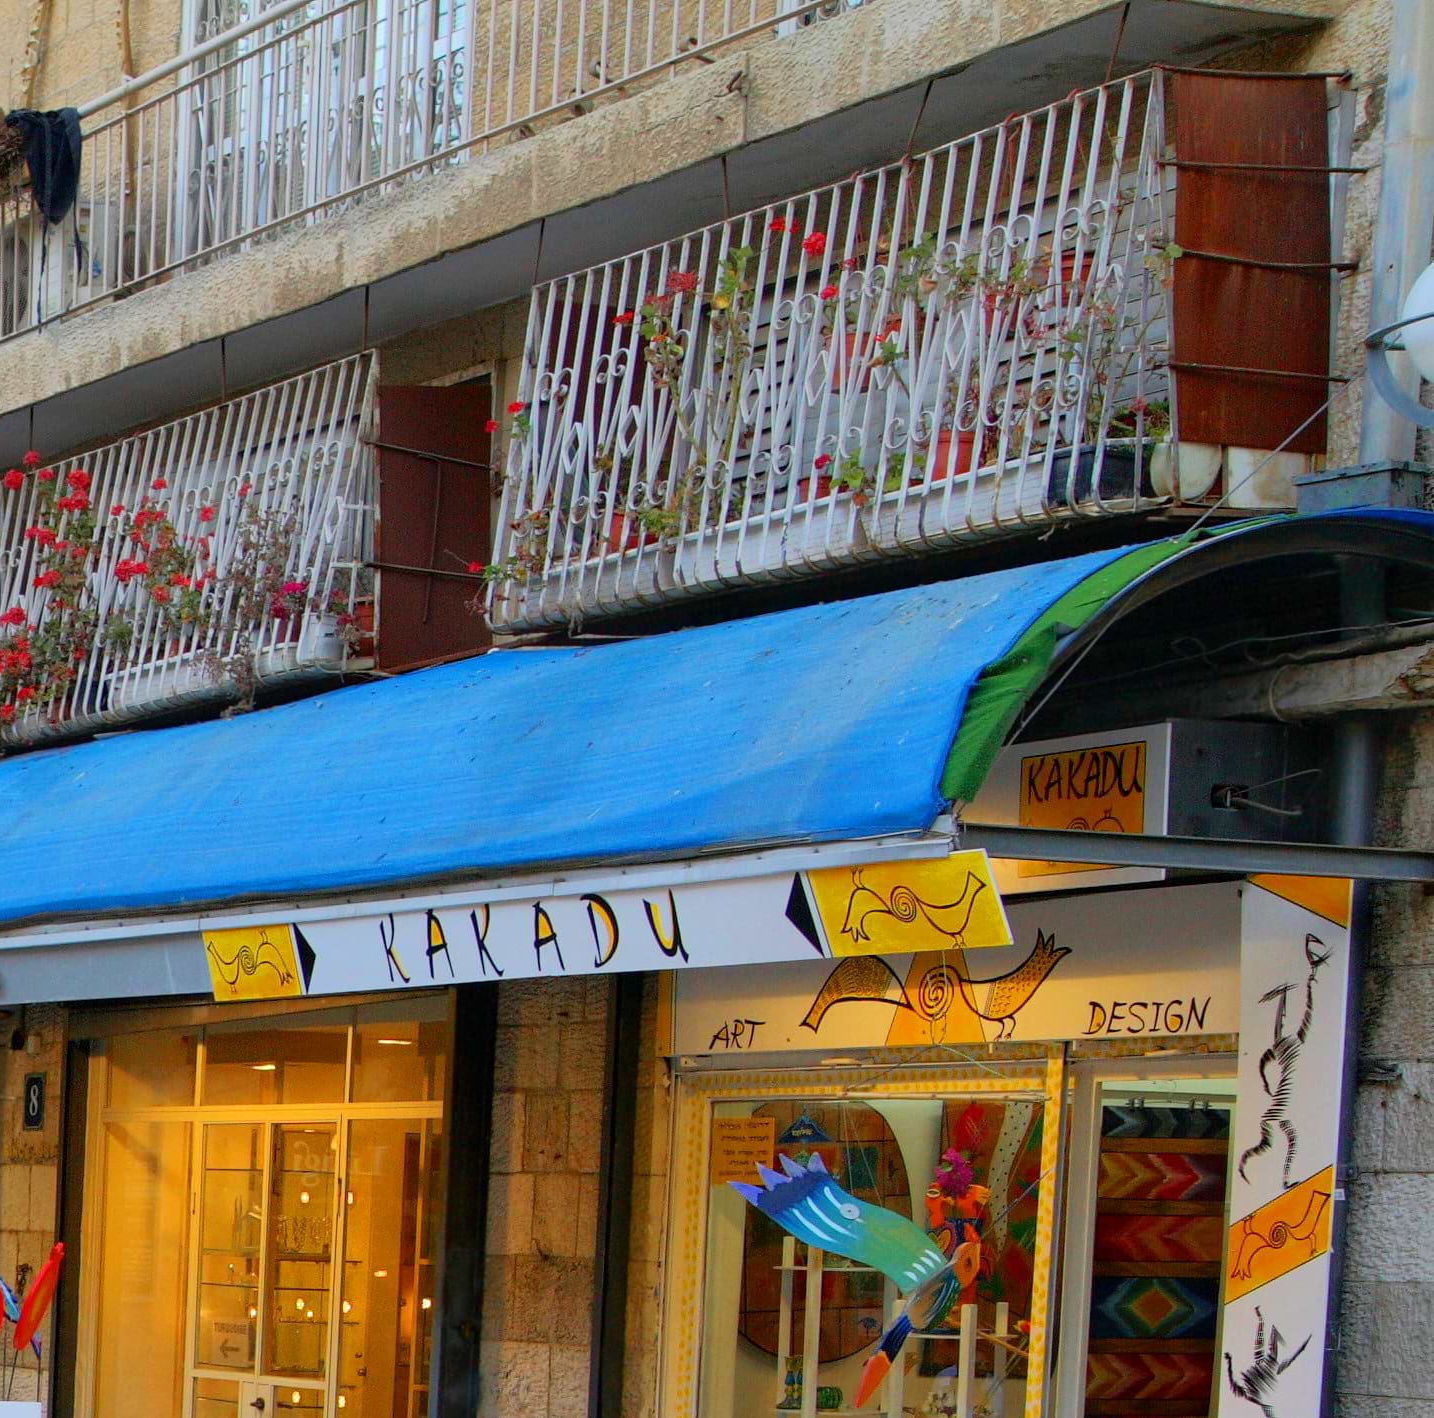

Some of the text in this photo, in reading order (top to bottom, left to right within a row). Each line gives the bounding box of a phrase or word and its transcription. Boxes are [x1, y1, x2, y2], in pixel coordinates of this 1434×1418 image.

[1027, 745, 1143, 804] KAKADU
[379, 887, 690, 984] KAKADU
[709, 1020, 766, 1050] ART
[1081, 996, 1211, 1036] DESIGN
[29, 1084, 39, 1116] 8
